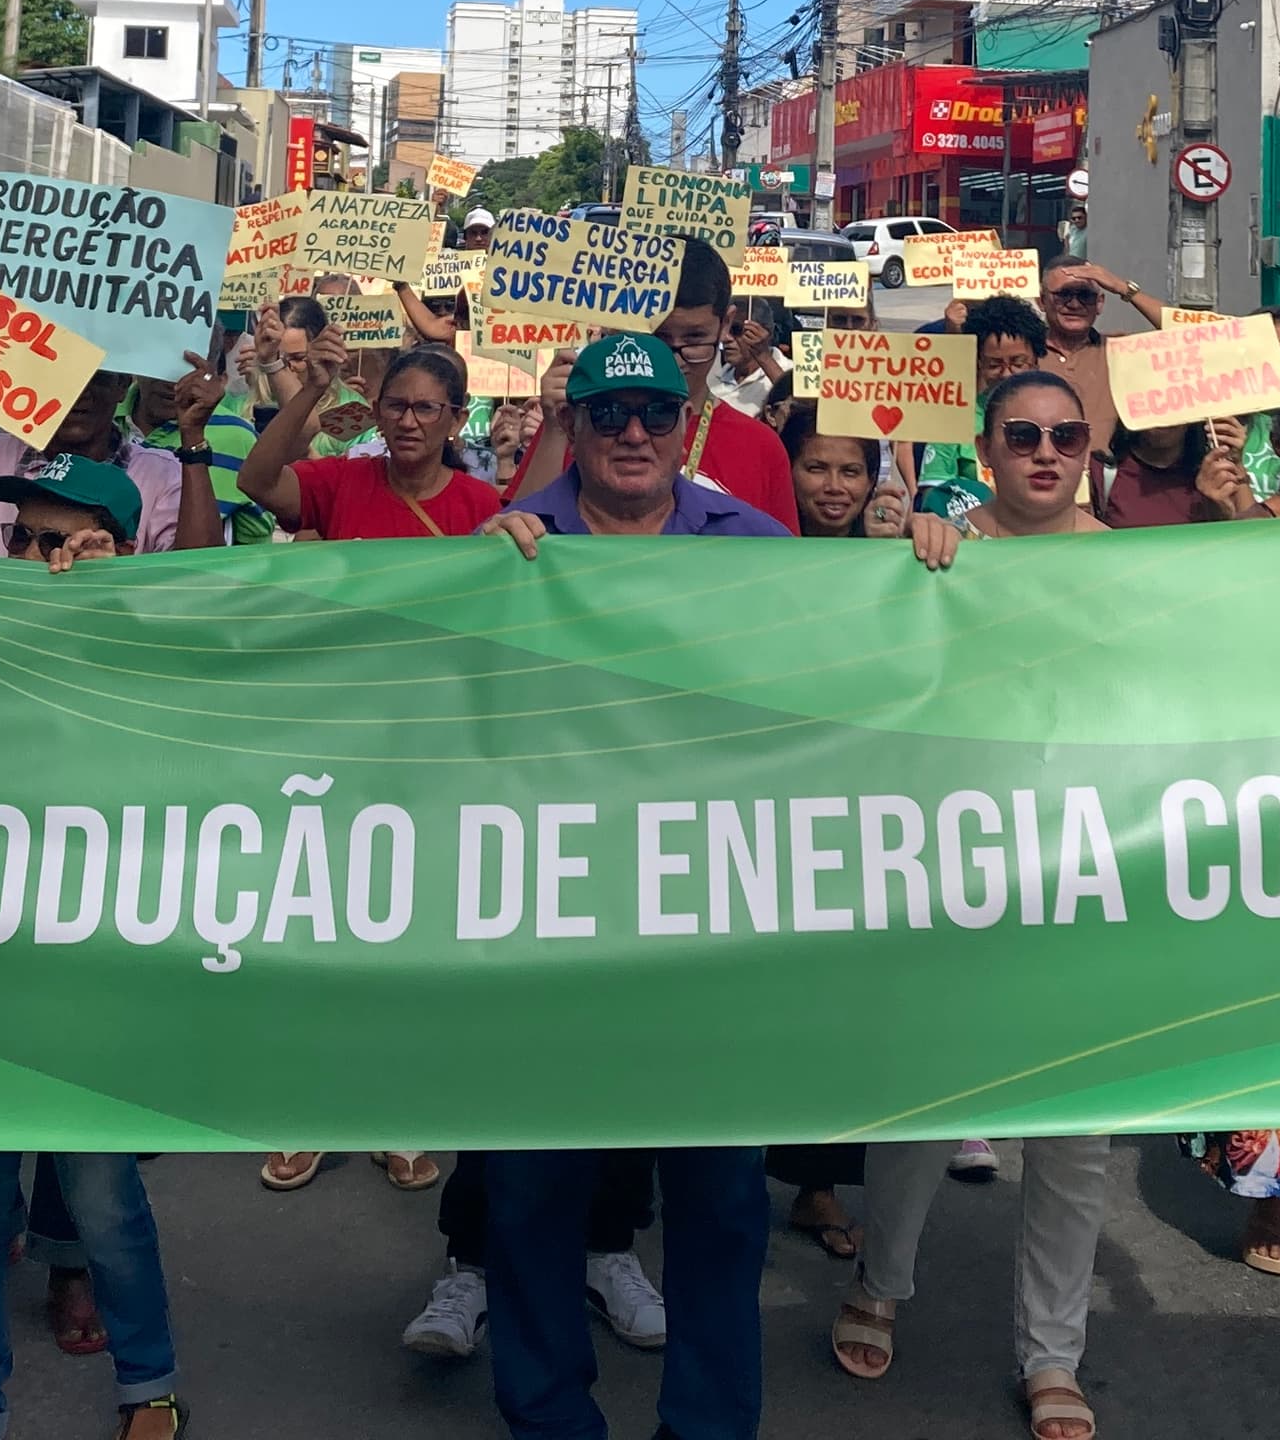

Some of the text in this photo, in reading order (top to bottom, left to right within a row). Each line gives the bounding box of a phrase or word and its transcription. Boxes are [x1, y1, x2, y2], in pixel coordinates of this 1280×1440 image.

[937, 133, 1005, 151] 3278.4045
[431, 174, 464, 190] SOLAR
[638, 171, 751, 199] ECONOMIA
[236, 199, 281, 219] NERGIA
[310, 195, 431, 223] A NATUREZA
[637, 187, 728, 215] LIMPA
[247, 205, 303, 229] RESPEITA
[626, 207, 734, 227] QUE CUIDA DO
[319, 219, 398, 234] AGRADECE
[252, 230, 264, 242] A
[306, 232, 391, 248] O BOLSO
[498, 210, 680, 267] MENOS CUSTOS,
[226, 232, 298, 266] ATUREZ
[438, 252, 459, 260] MAIS
[744, 247, 778, 255] VAÇÃO
[961, 250, 1024, 260] INOVAÇÃO
[303, 249, 406, 275] TAMBÉM
[491, 238, 669, 286] MAIS ENERGIA
[743, 255, 784, 263] LUMINA
[979, 260, 1036, 269] ILUMINA
[425, 260, 473, 276] SUSTENTA
[791, 263, 825, 274] MAIS
[912, 266, 953, 279] ECON
[280, 277, 310, 294] LAR
[427, 275, 462, 290] LIDAD
[731, 273, 778, 287] UTURO
[799, 272, 859, 286] ENERGIA
[956, 275, 1028, 290] FUTURO
[221, 281, 268, 296] MAIS
[812, 286, 865, 302] LIMPA!
[325, 296, 360, 311] SOL,
[329, 309, 395, 322] CONOMIA
[491, 322, 581, 344] BARATA
[833, 333, 890, 351] VIVA
[914, 336, 932, 352] O
[605, 352, 653, 367] PALMA
[824, 353, 945, 377] FUTURO
[1151, 346, 1204, 371] LUZ
[605, 364, 655, 378] SOLAR
[1167, 367, 1203, 383] EM
[821, 376, 968, 408] SUSTENTÁVEL
[455, 802, 597, 941] DE
[637, 785, 1128, 936] ENERGIA
